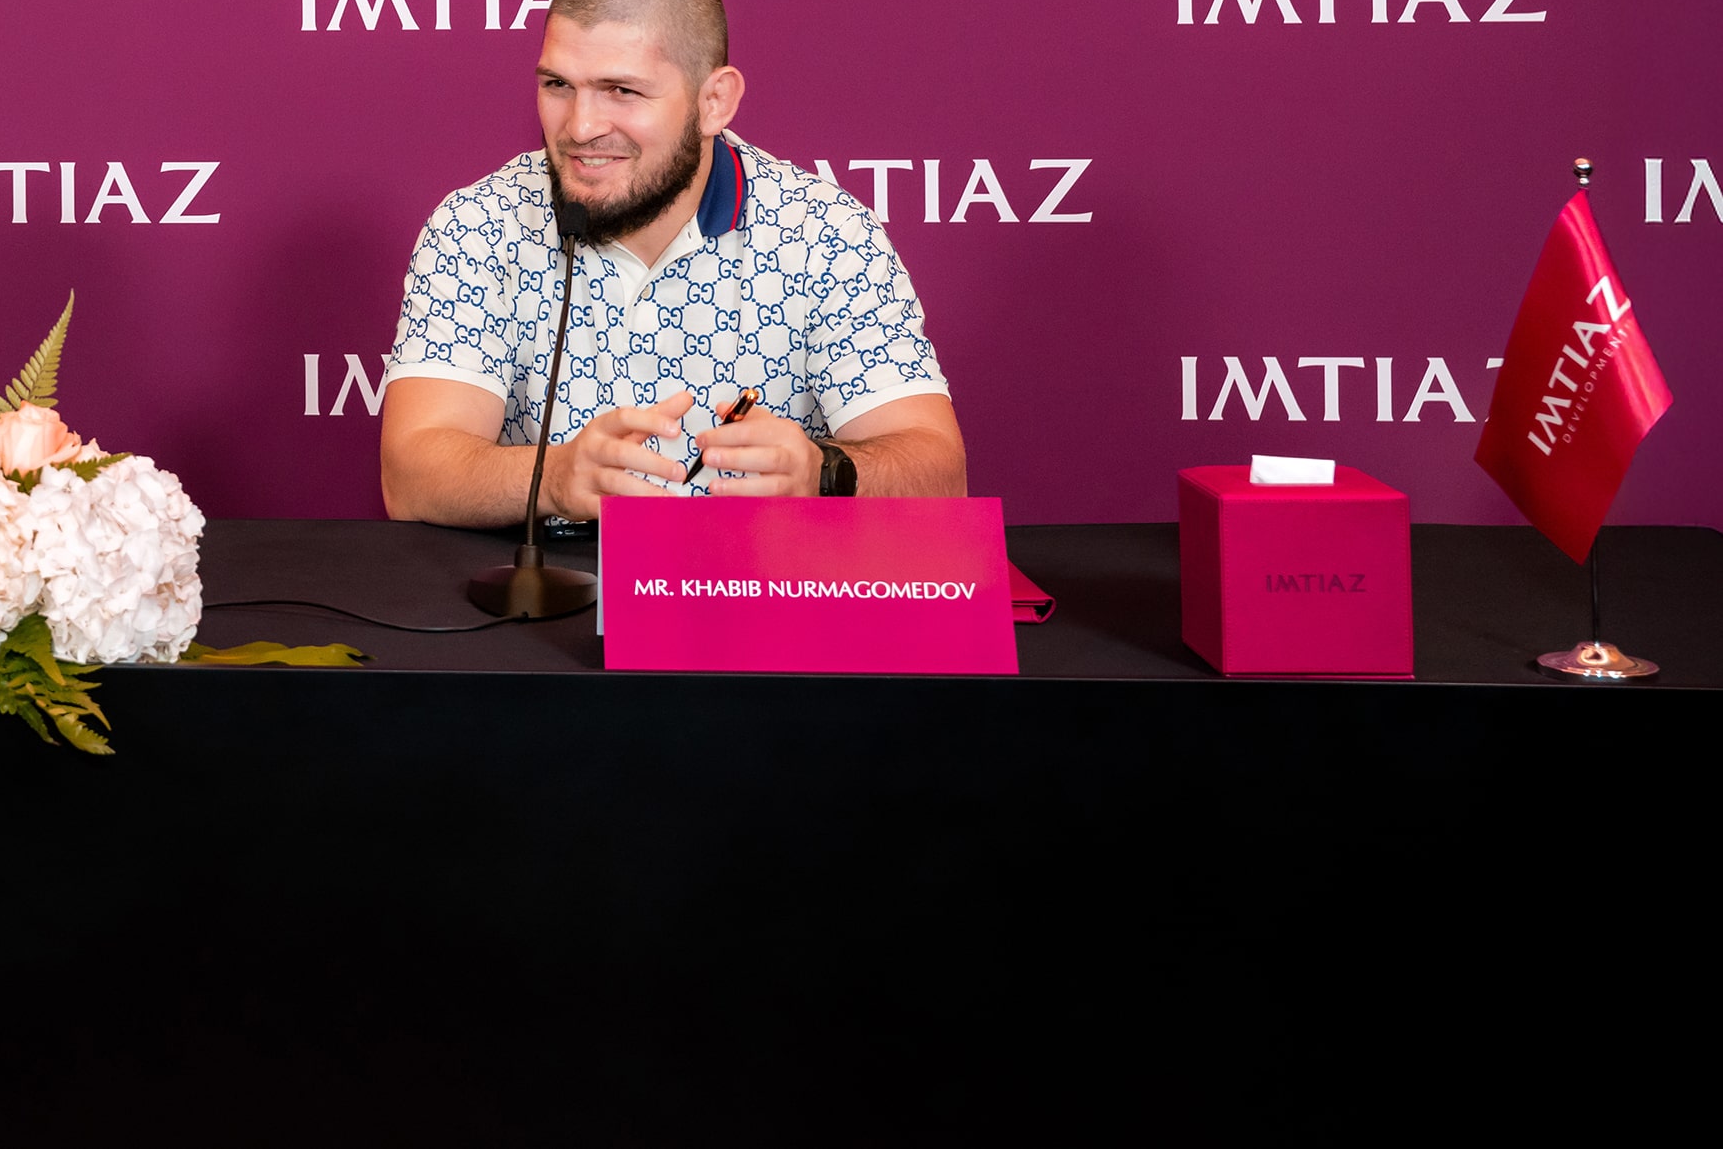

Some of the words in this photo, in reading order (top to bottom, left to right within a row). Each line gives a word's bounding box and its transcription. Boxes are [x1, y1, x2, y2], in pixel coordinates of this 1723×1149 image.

[777, 159, 1092, 222] TIAZ
[1181, 357, 1504, 423] IMTIA
[1528, 275, 1631, 456] IMTIAZ
[634, 579, 675, 596] MR.
[681, 579, 762, 597] KHABIB
[768, 580, 976, 600] NURMAGOMEDOV
[1265, 573, 1367, 593] IMTIAZ
